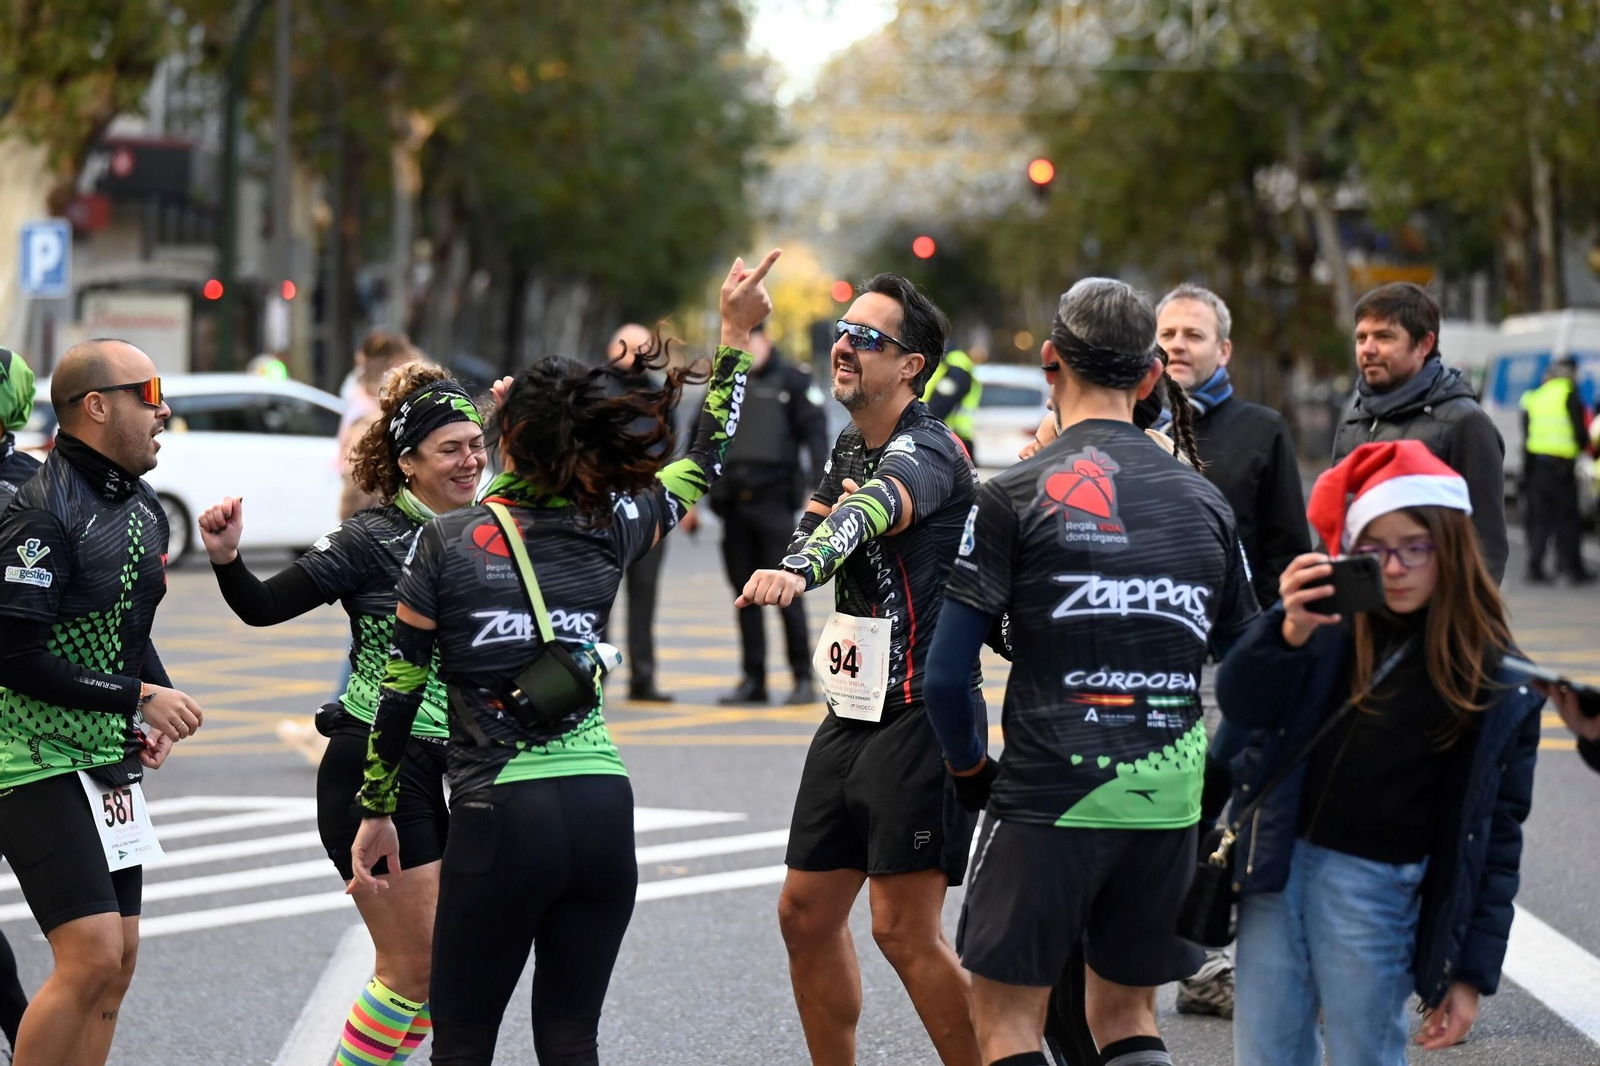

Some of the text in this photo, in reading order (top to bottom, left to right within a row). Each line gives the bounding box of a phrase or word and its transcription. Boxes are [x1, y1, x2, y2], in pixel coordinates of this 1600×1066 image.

[30, 231, 62, 289] P
[829, 513, 859, 553] eyas
[1065, 521, 1097, 532] Regala
[1065, 532, 1128, 545] dona órganos
[486, 563, 511, 572] Regala
[1052, 575, 1209, 640] Zappas
[829, 641, 859, 679] 94
[1064, 665, 1197, 690] CÓRDOBA
[101, 788, 135, 828] 587
